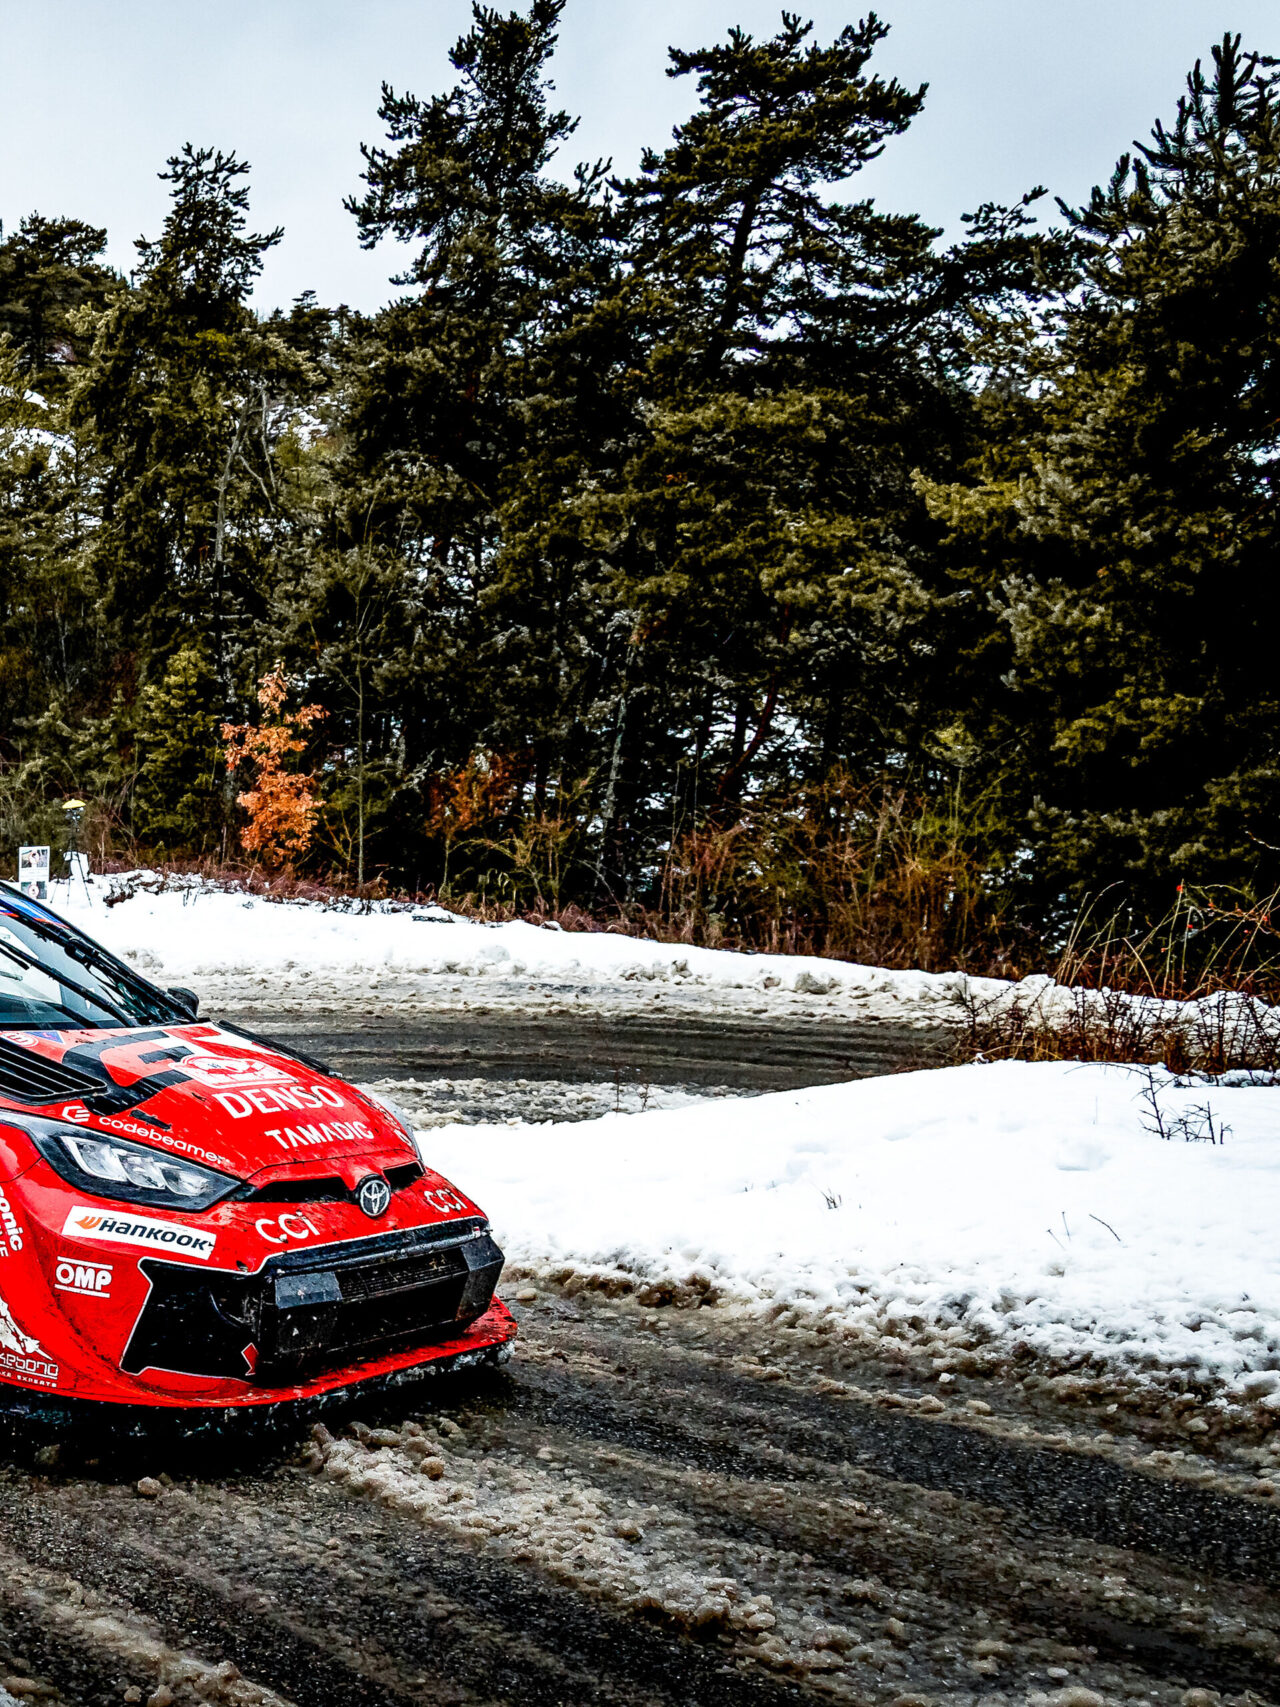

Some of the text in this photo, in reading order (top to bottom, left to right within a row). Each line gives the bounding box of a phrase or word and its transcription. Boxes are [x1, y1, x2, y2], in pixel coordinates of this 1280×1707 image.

[211, 1085, 345, 1119] DENSO
[99, 1116, 231, 1164] codebeamer
[264, 1121, 375, 1149] TAMADIC
[55, 1262, 113, 1291] OMP
